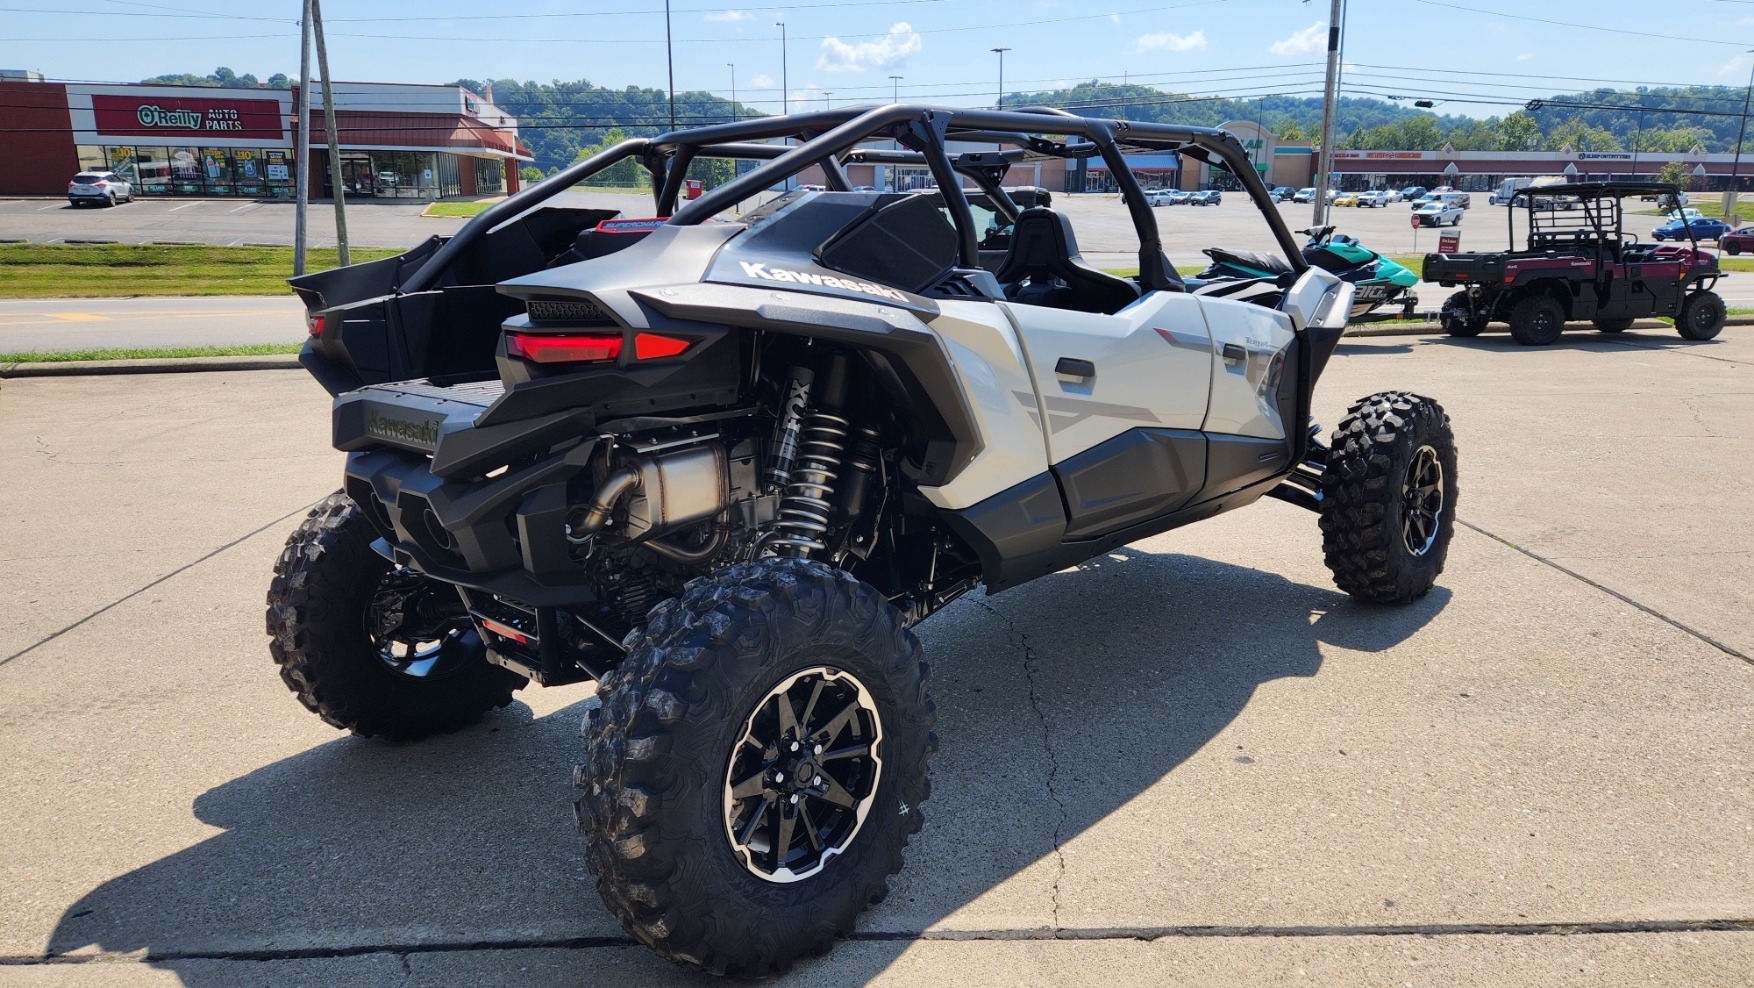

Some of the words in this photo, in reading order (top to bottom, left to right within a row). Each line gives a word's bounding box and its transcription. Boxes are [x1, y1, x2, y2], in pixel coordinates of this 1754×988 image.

[138, 105, 201, 129] O'Reilly
[205, 120, 242, 130] PARTS
[208, 109, 238, 119] AUTO
[739, 261, 910, 303] Kawasaki
[368, 408, 439, 447] Kawasaki
